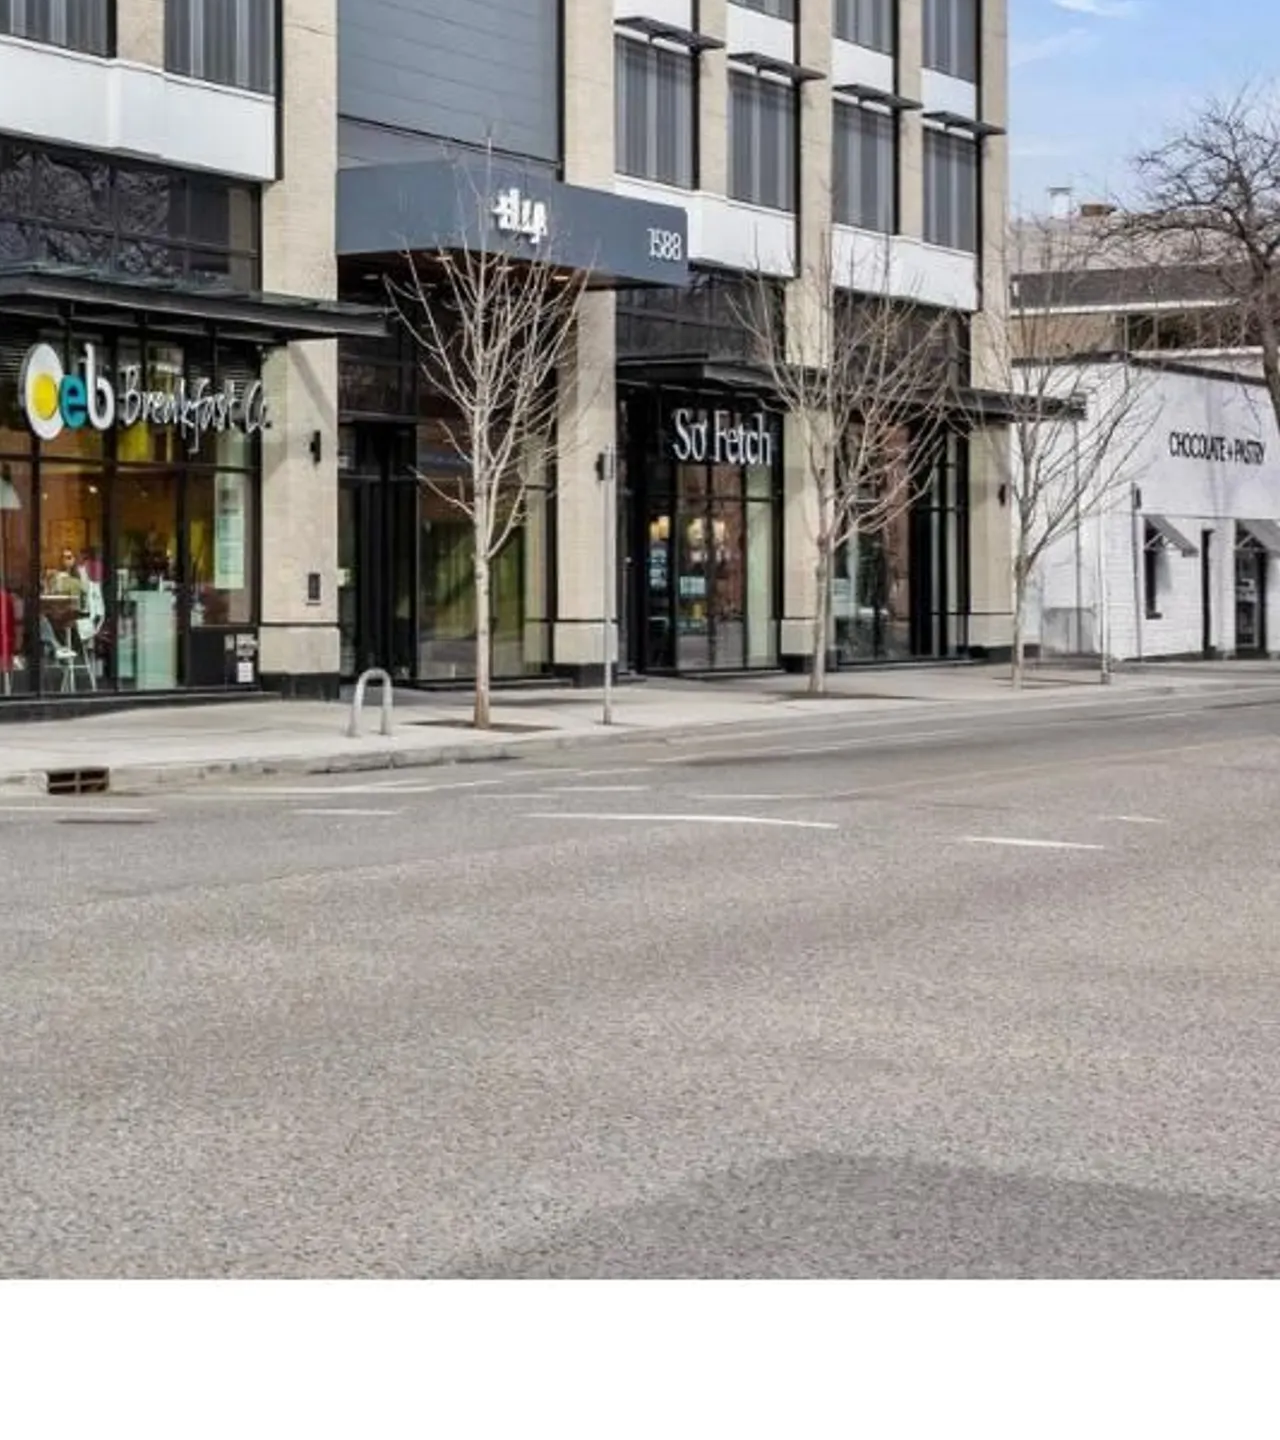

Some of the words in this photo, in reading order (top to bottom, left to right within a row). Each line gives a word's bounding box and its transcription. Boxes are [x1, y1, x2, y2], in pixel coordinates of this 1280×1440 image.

[646, 228, 682, 260] 1588
[120, 364, 238, 454] Breakfast
[673, 408, 707, 464] So
[714, 409, 772, 467] Fetch
[1169, 432, 1226, 462] CHOCOLATE
[1234, 439, 1266, 465] PASTRY
